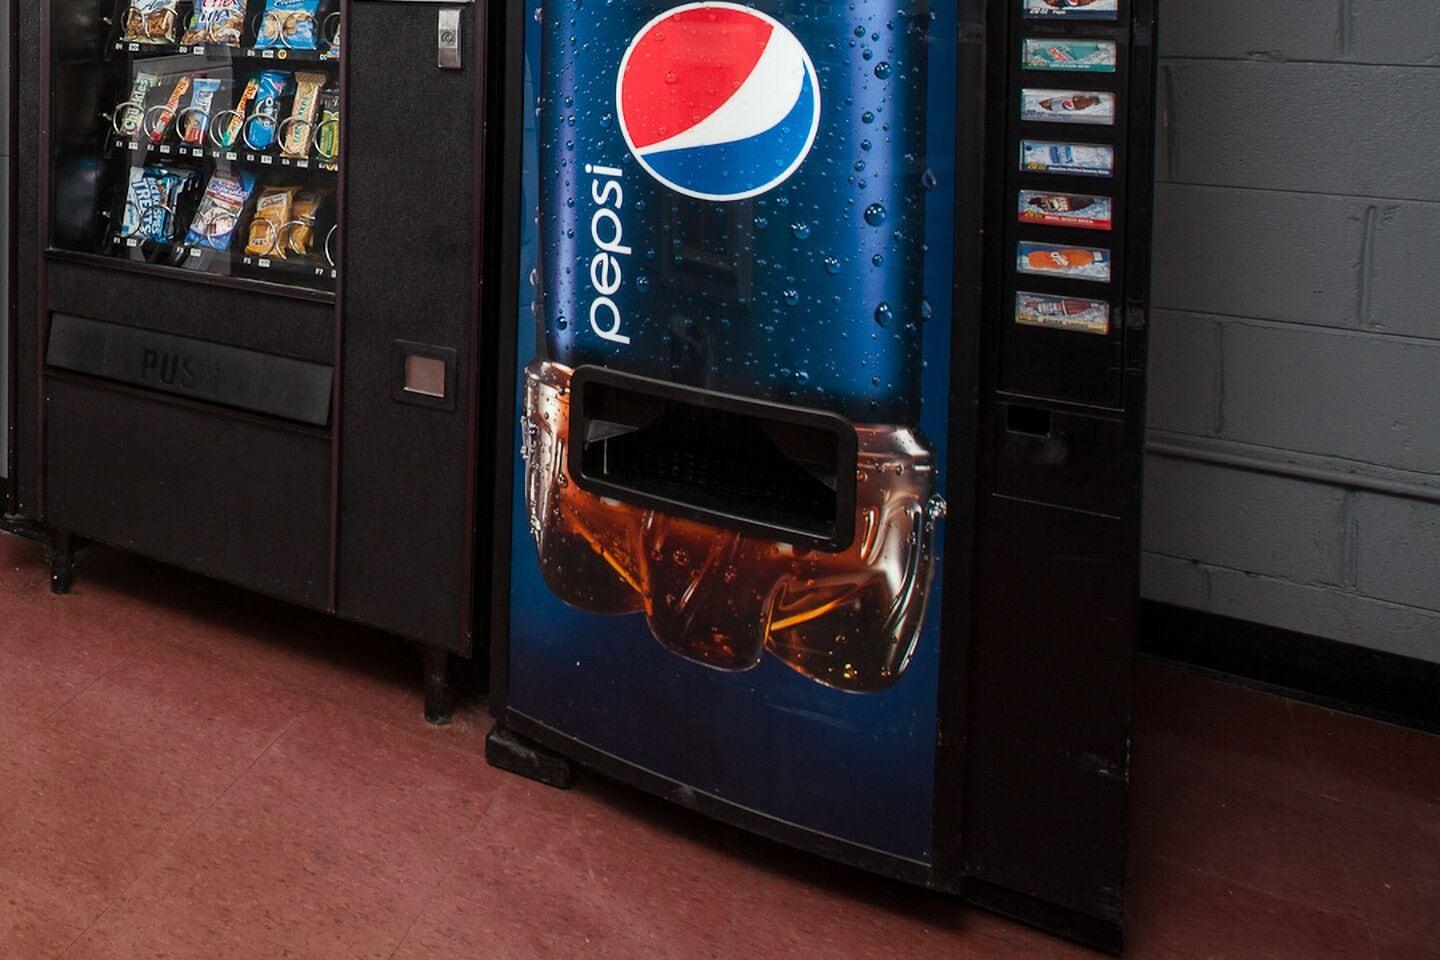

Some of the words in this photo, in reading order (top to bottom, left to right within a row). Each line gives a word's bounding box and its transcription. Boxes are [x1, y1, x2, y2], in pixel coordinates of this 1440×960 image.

[123, 80, 149, 130] Chukles
[131, 178, 153, 239] TREATS
[585, 164, 632, 345] pepsi
